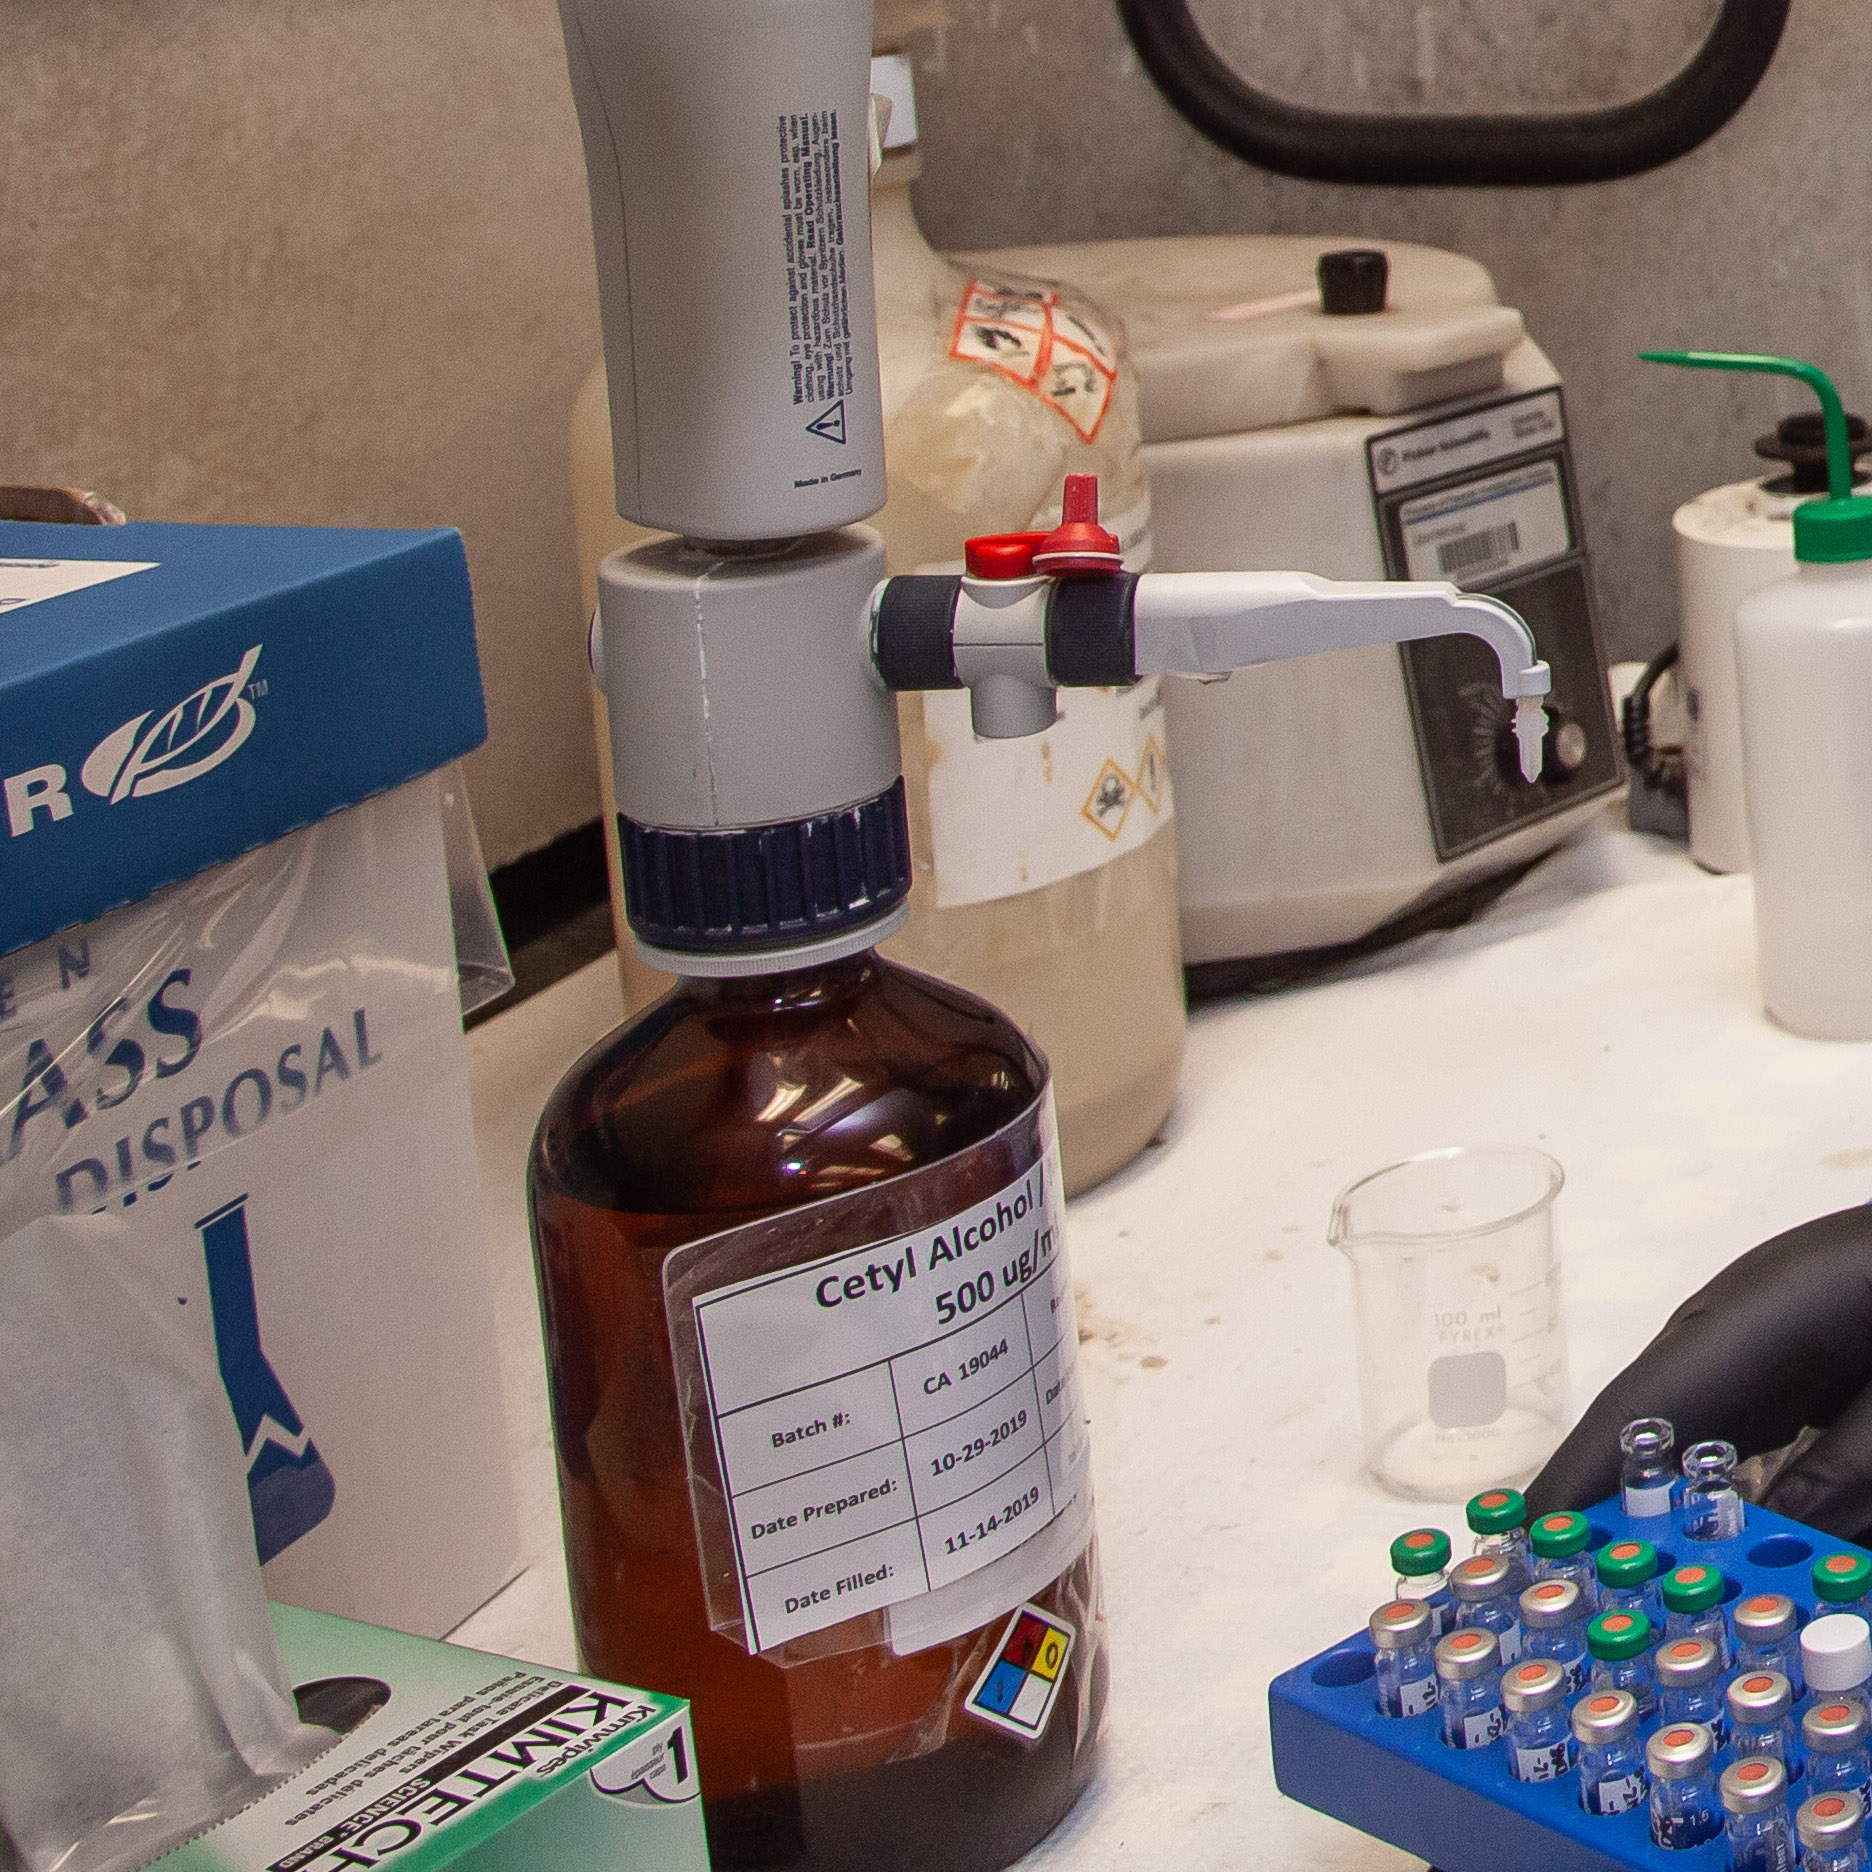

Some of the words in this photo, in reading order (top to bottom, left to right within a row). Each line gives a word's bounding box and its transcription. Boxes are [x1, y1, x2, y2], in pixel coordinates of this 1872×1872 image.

[777, 116, 790, 163] protective
[788, 114, 798, 141] when
[800, 113, 810, 157] Manual.
[820, 111, 829, 134] beim
[780, 168, 792, 210] splashes
[793, 197, 802, 209] be
[803, 161, 815, 216] Operating
[782, 214, 795, 263] accidental
[794, 213, 804, 236] must
[806, 220, 816, 249] Read
[796, 239, 808, 269] gloves
[785, 268, 798, 301] against
[797, 273, 808, 290] and
[788, 305, 802, 340] protect
[800, 294, 812, 340] protection
[810, 298, 822, 347] hazardous
[821, 293, 831, 324] Schutz
[789, 345, 800, 356] To
[802, 344, 813, 360] eye
[822, 328, 833, 349] Zum
[834, 344, 843, 361] und
[813, 351, 823, 371] with
[824, 353, 835, 400] Warnung!
[790, 361, 804, 405] Warning!
[816, 375, 826, 401] using
[57, 1007, 383, 1208] DISPOSAL
[815, 1246, 918, 1308] Cetyl
[929, 1183, 1034, 1271] Alcohol
[935, 1270, 995, 1325] 500
[1434, 1310, 1467, 1328] 100
[923, 1370, 951, 1395] CA
[959, 1338, 1009, 1381] 19044
[771, 1414, 828, 1449] Batch
[831, 1407, 851, 1430] #:
[931, 1409, 1028, 1477] 10-29-2019
[750, 1511, 798, 1540] Date
[803, 1479, 898, 1528] Prepared:
[944, 1485, 1041, 1556] 11-14-2019
[784, 1588, 831, 1614] Date
[836, 1564, 895, 1599] Filled:
[438, 1695, 476, 1717] para
[496, 1679, 563, 1716] Delicate
[387, 1717, 441, 1747] tareas
[421, 1722, 456, 1746] pour
[458, 1716, 499, 1738] Task
[536, 1704, 656, 1778] Kimwipes
[304, 1747, 387, 1796] delicadas
[363, 1744, 422, 1779] tâches
[398, 1739, 462, 1774] Wipers
[667, 1726, 688, 1784] 1
[284, 1778, 364, 1826] délicates
[278, 1836, 335, 1869] BRAND
